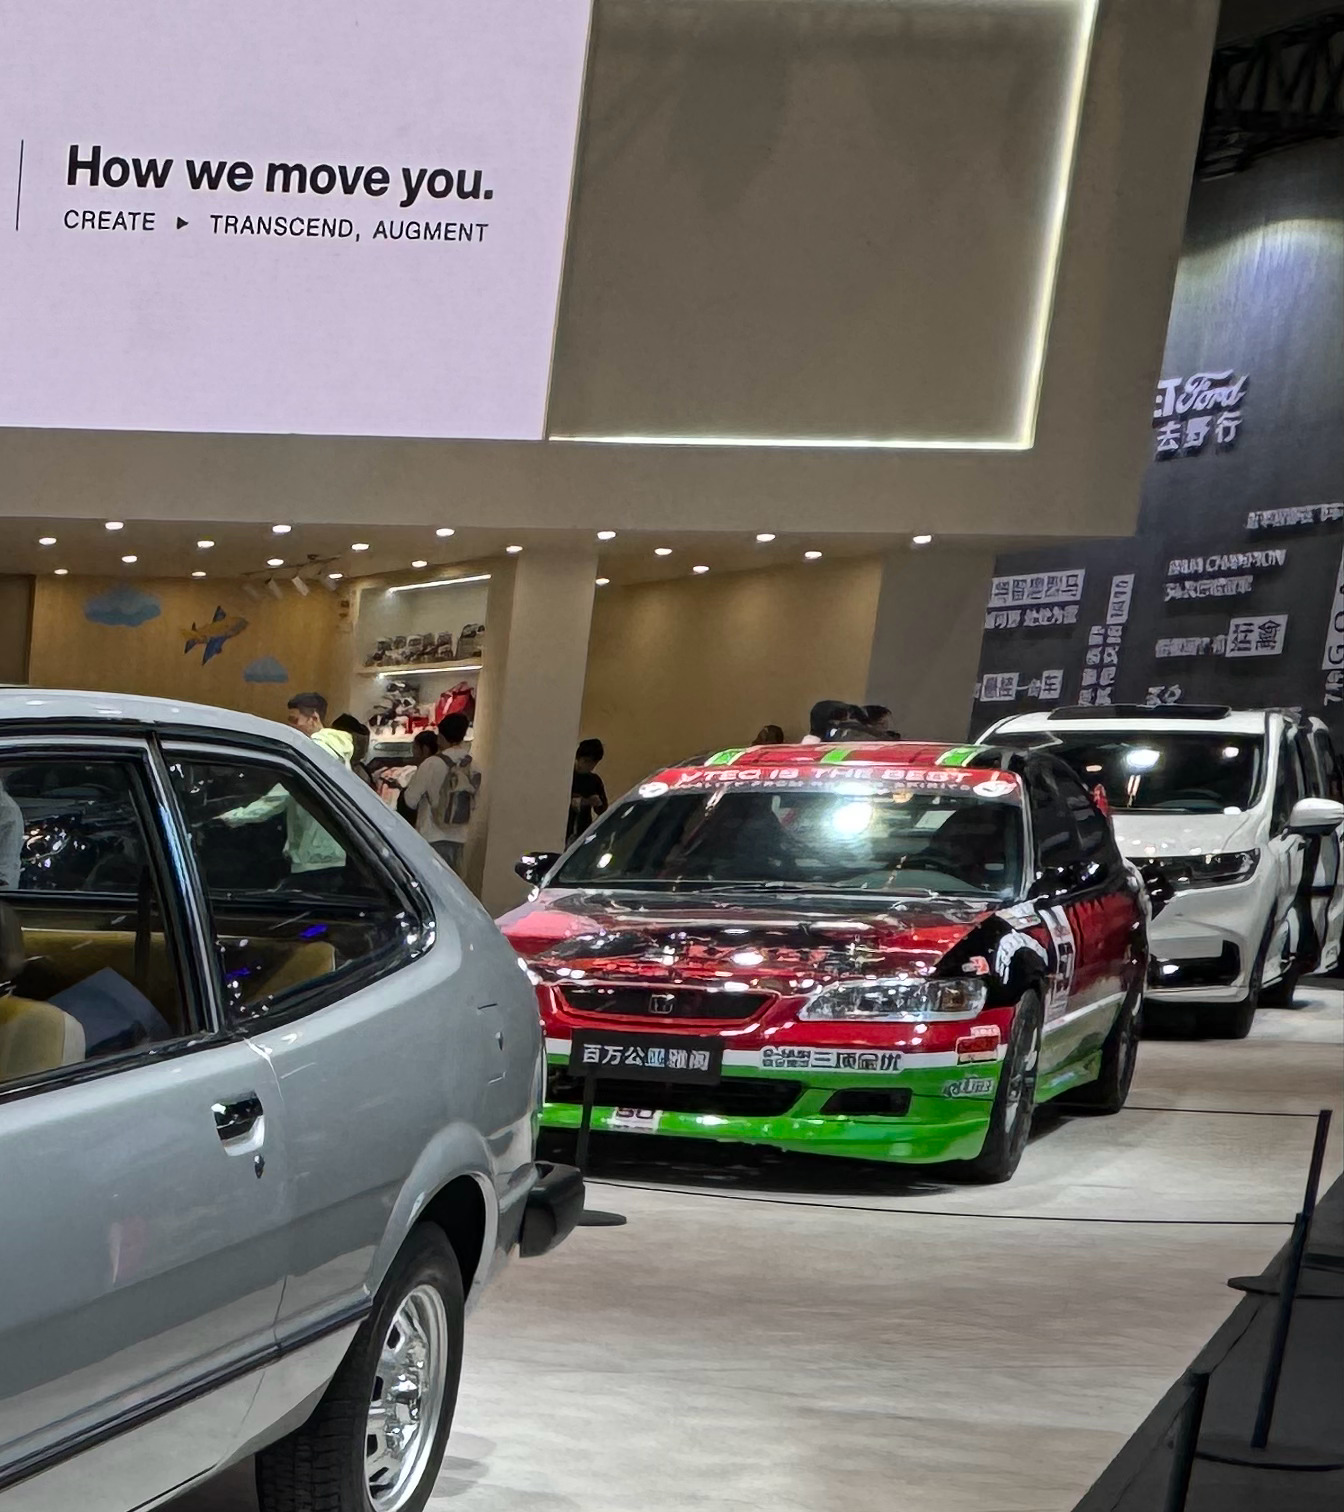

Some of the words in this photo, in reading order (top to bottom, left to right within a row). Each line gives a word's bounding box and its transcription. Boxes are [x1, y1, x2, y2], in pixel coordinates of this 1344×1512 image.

[66, 144, 173, 189] How
[186, 158, 253, 190] we
[266, 162, 390, 196] move
[399, 167, 494, 207] you.
[64, 210, 156, 231] CREATE
[210, 215, 360, 241] TRANSCEND,
[372, 220, 489, 242] AUGMENT
[1175, 369, 1249, 414] Ford
